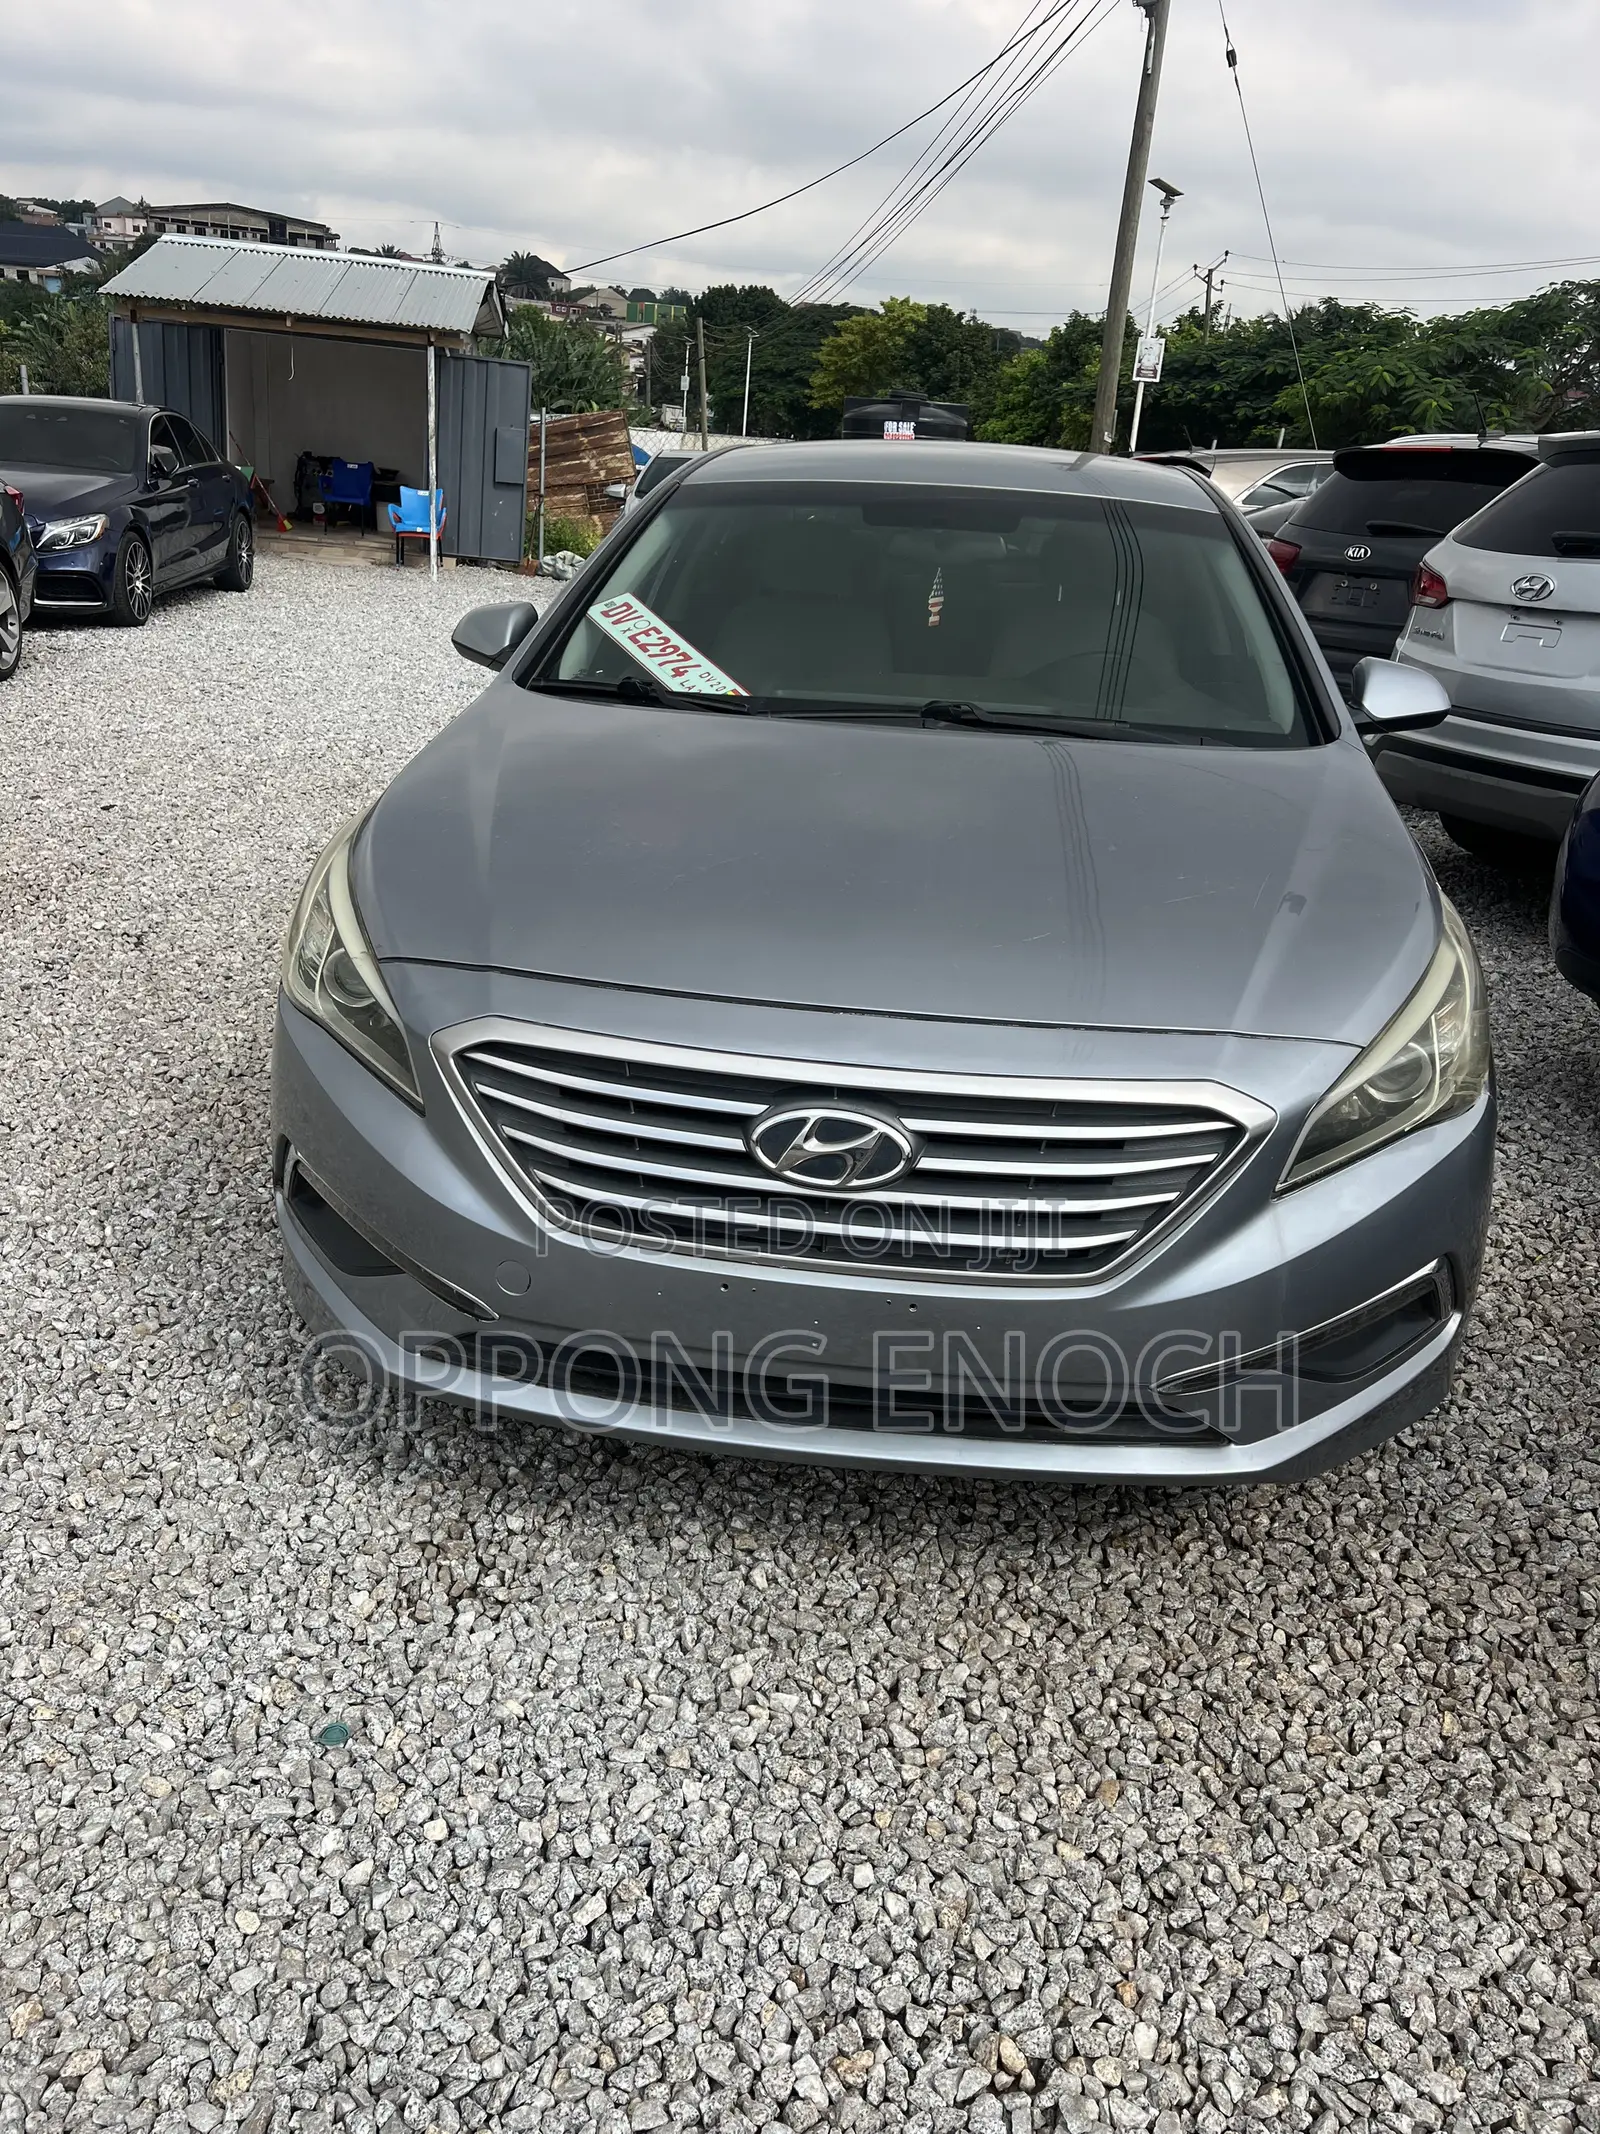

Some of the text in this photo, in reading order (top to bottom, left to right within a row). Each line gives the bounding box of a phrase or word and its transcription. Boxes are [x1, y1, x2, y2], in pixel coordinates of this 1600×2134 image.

[884, 421, 915, 433] FOR SALE
[1347, 547, 1365, 558] KIA
[600, 601, 702, 679] DV E2974
